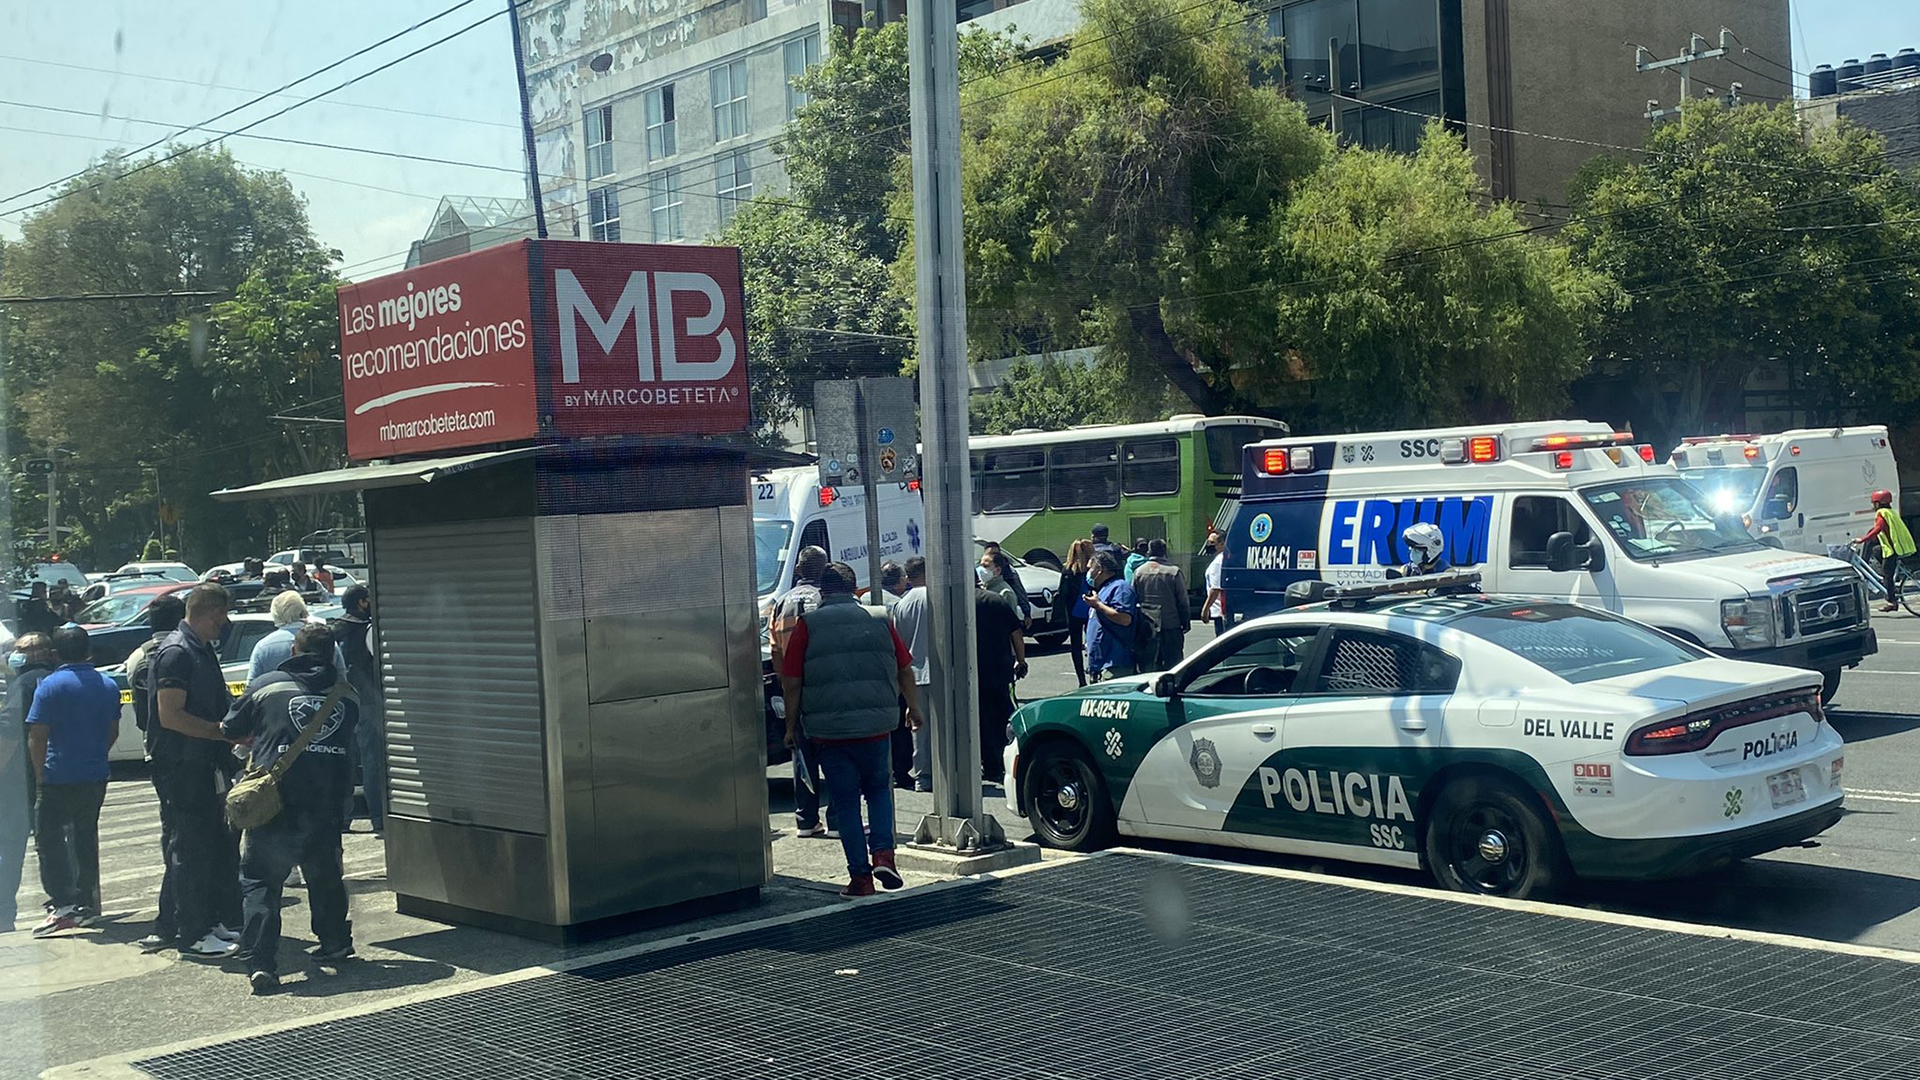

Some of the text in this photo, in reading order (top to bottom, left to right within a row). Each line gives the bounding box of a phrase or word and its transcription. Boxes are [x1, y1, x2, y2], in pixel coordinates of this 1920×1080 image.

[343, 282, 462, 336] Las mejores
[554, 269, 736, 384] MB
[346, 319, 526, 380] recomendaciones
[565, 394, 580, 407] BY
[379, 409, 496, 442] mbmarcobeteta.com
[1400, 438, 1440, 458] SSC
[757, 483, 775, 500] 22
[1328, 496, 1494, 566] ERUM
[840, 545, 870, 562] AMBULAN
[1246, 545, 1291, 570] MX-841-C1
[1336, 570, 1386, 579] ESCUAD
[1080, 699, 1130, 720] MX-025-K2
[1524, 718, 1614, 740] DEL VALLE
[1742, 731, 1798, 760] POLICIA
[1576, 765, 1608, 776] 911
[1258, 766, 1415, 822] POLICIA
[1371, 823, 1405, 850] SSC
